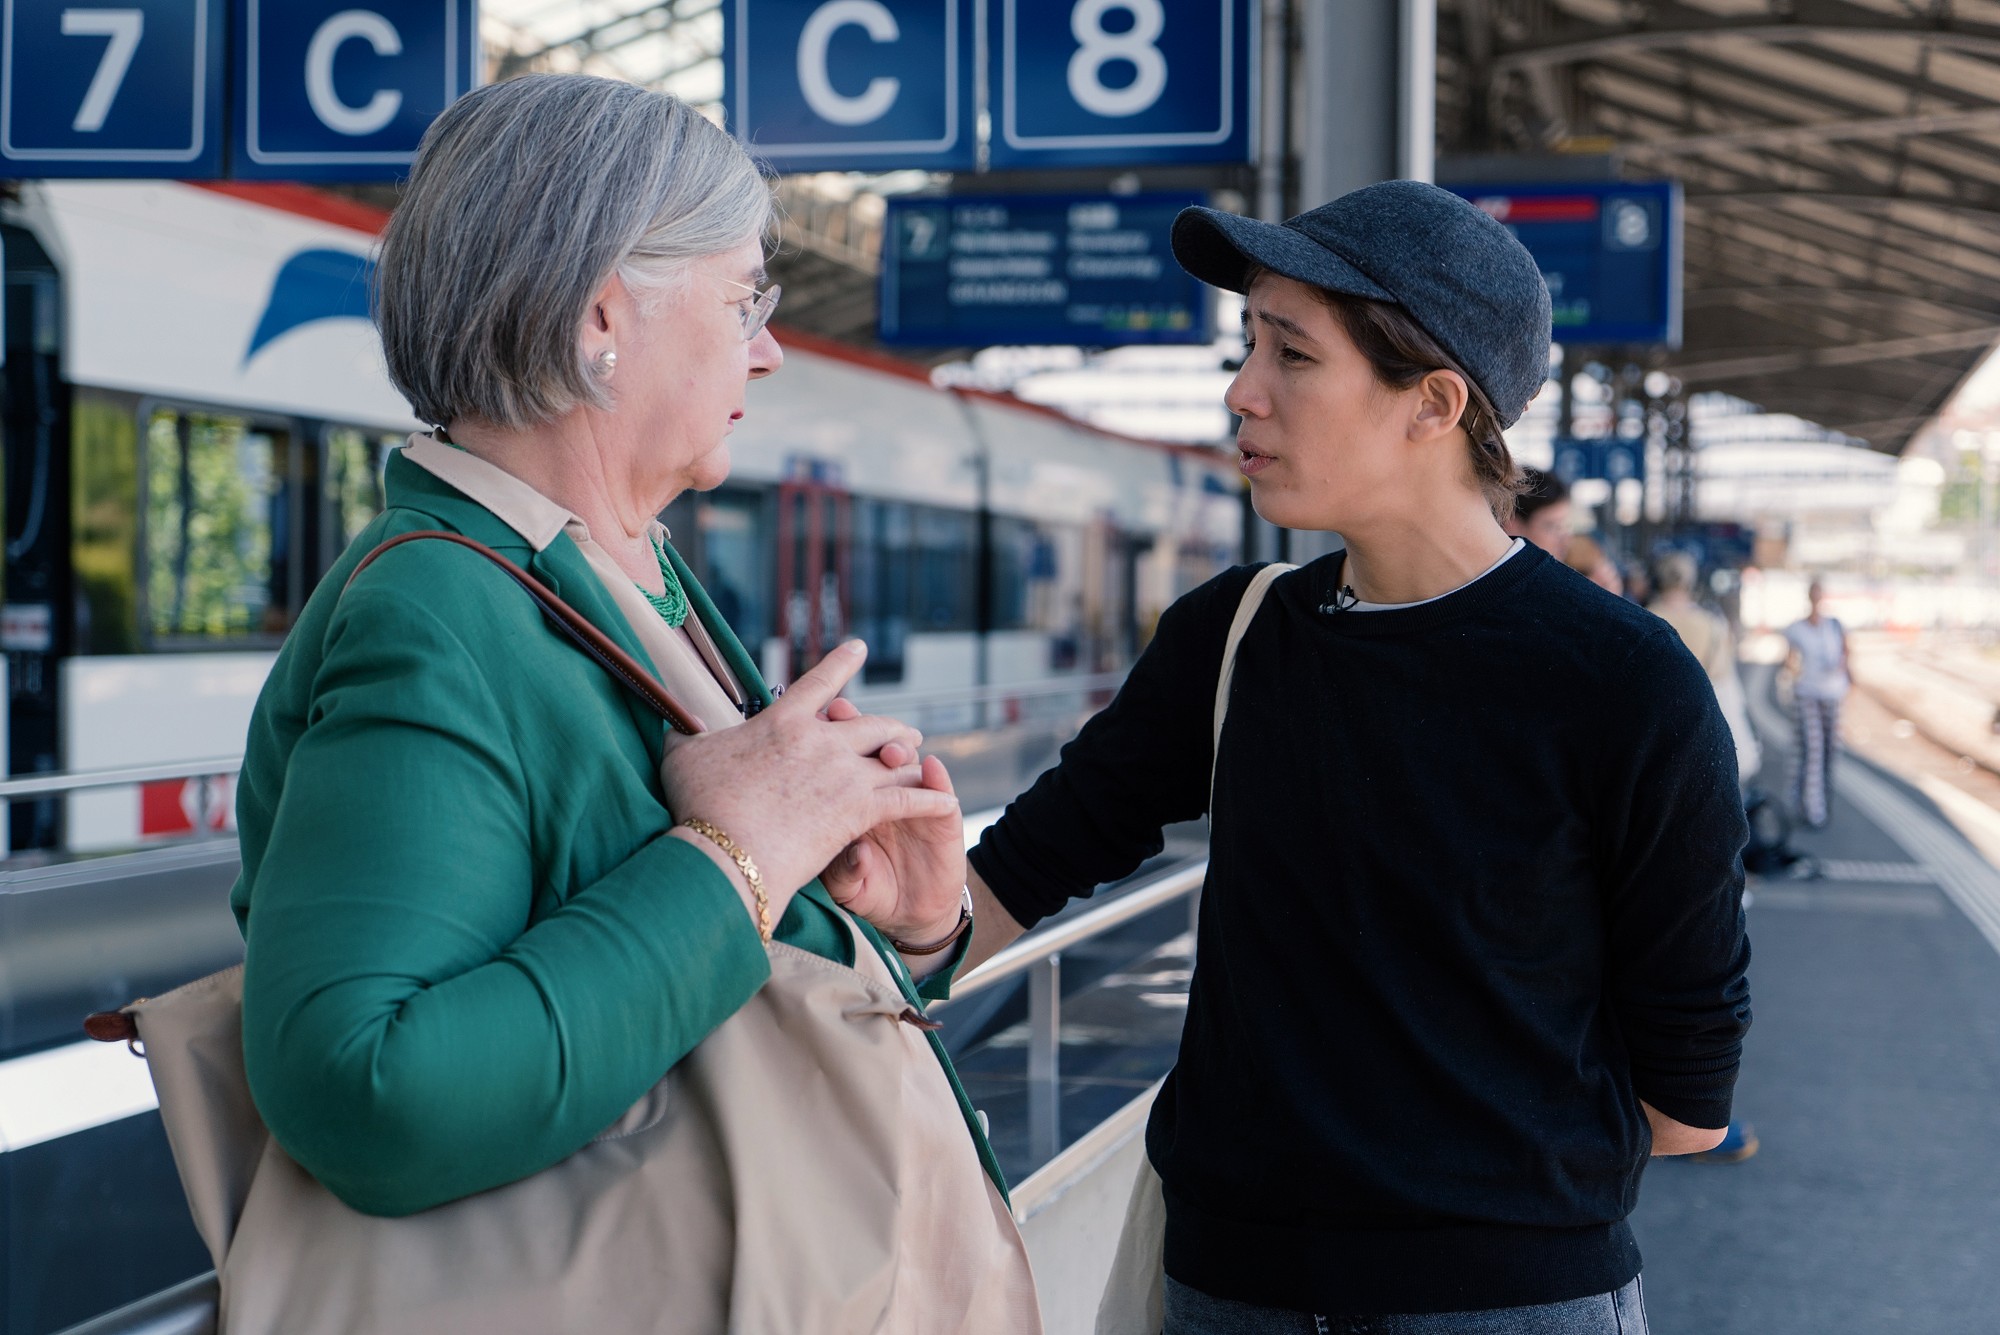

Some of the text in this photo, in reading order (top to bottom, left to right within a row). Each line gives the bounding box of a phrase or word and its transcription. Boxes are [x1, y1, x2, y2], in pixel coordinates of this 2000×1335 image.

[60, 8, 144, 132] 7
[304, 9, 404, 136] C
[796, 0, 901, 126] C
[1066, 0, 1168, 117] 8
